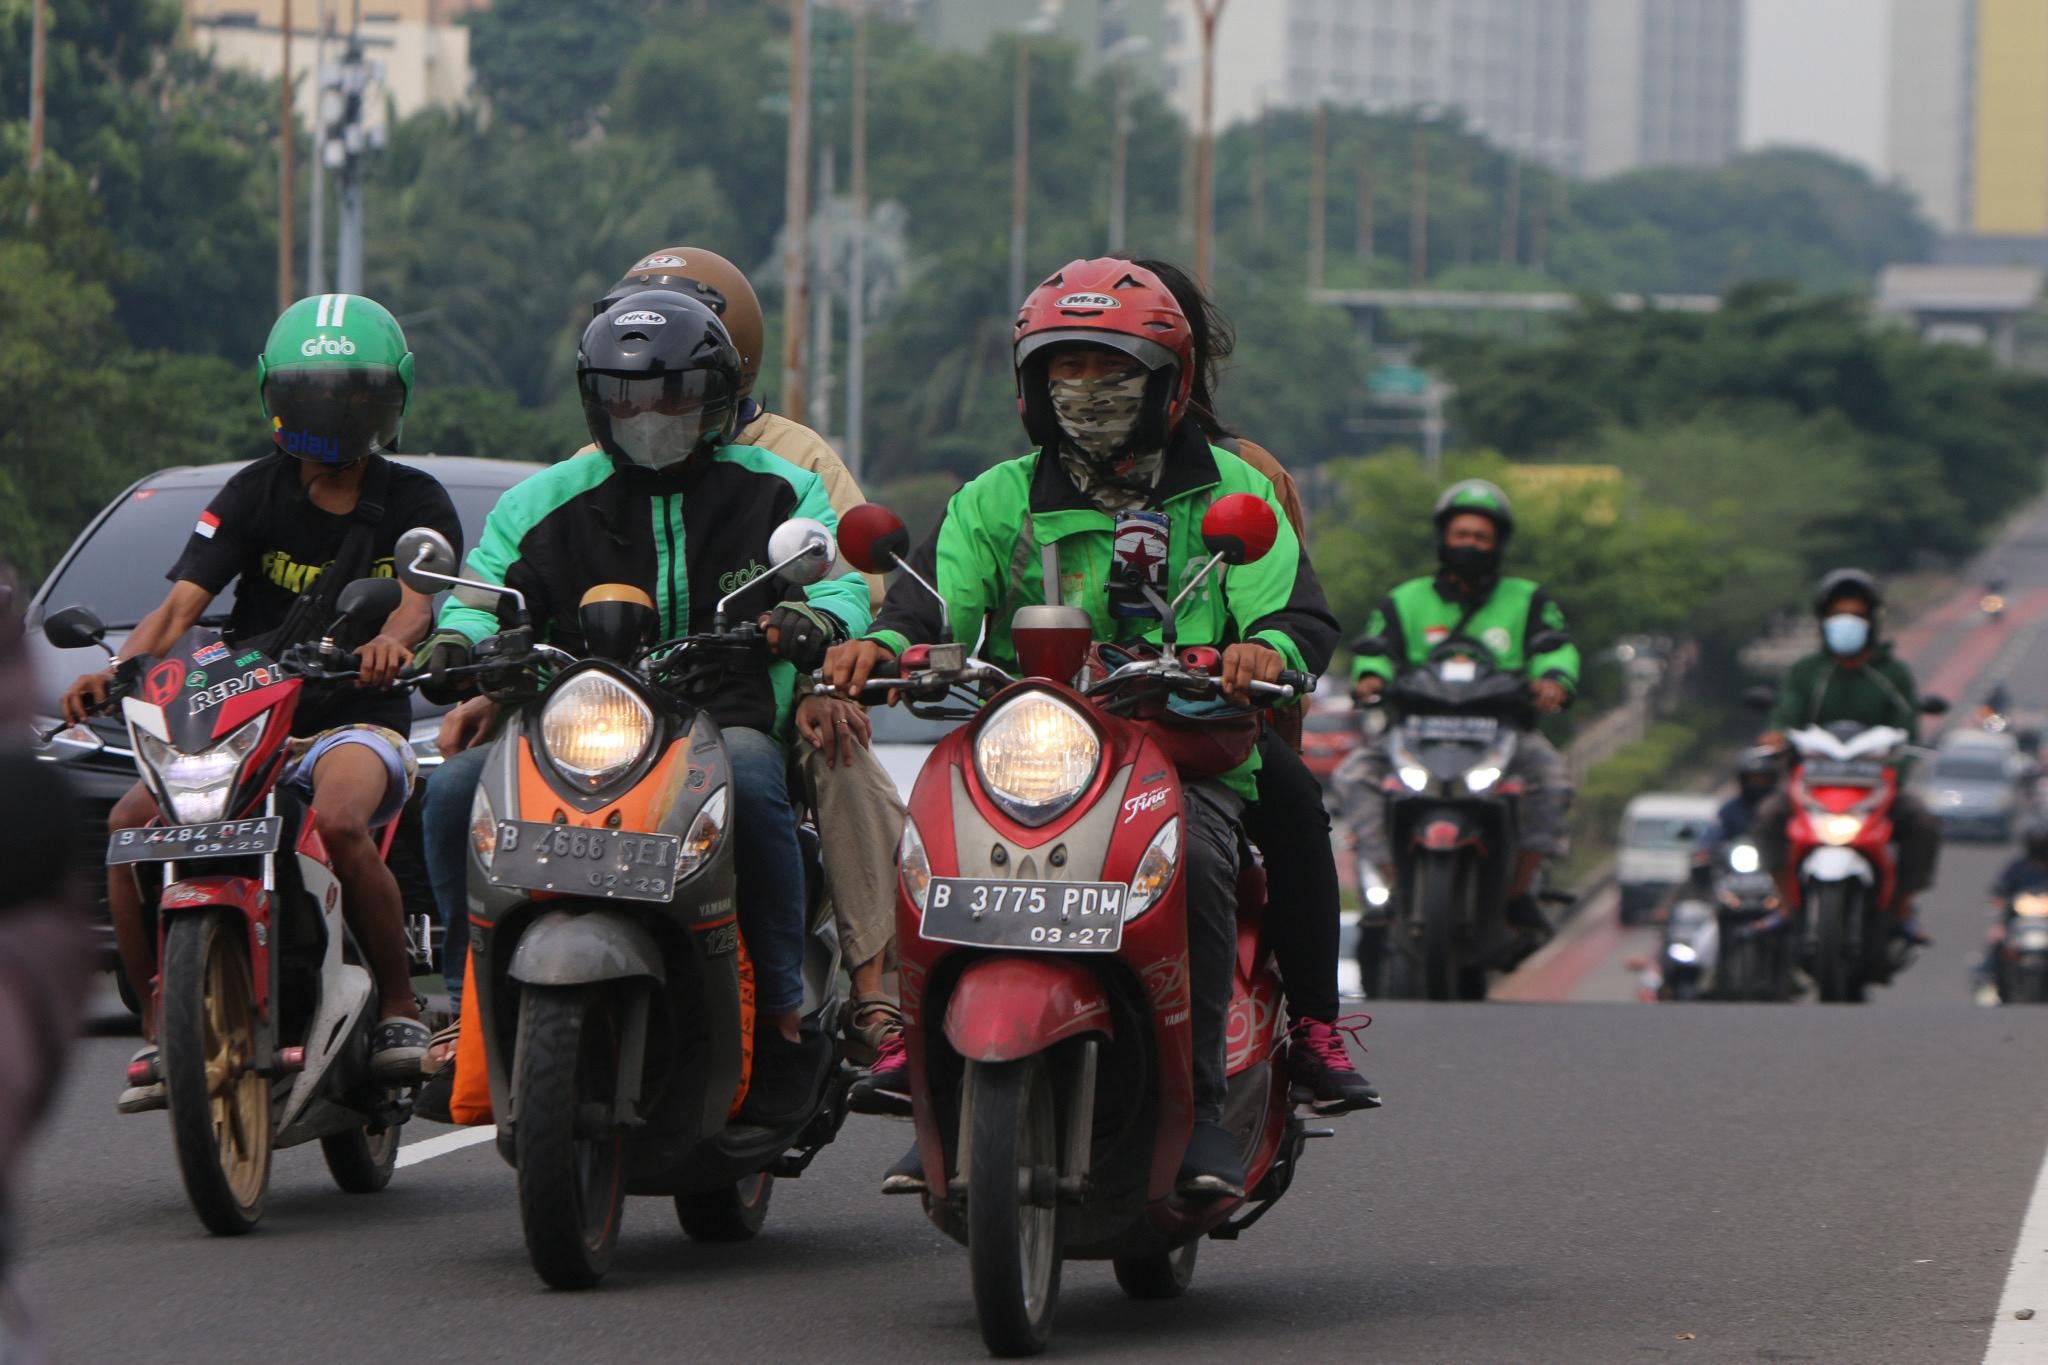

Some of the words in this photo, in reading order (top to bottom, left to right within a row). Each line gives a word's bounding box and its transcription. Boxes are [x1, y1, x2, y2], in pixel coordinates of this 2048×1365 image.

[301, 335, 356, 357] Grab
[234, 650, 263, 668] BIKE
[188, 663, 283, 716] REPSOL
[1124, 787, 1171, 824] Fino
[119, 831, 136, 846] B
[501, 825, 519, 851] B
[535, 830, 606, 860] 4666
[933, 884, 951, 908] B
[969, 886, 1047, 914] 3775
[1061, 888, 1121, 915] PDM
